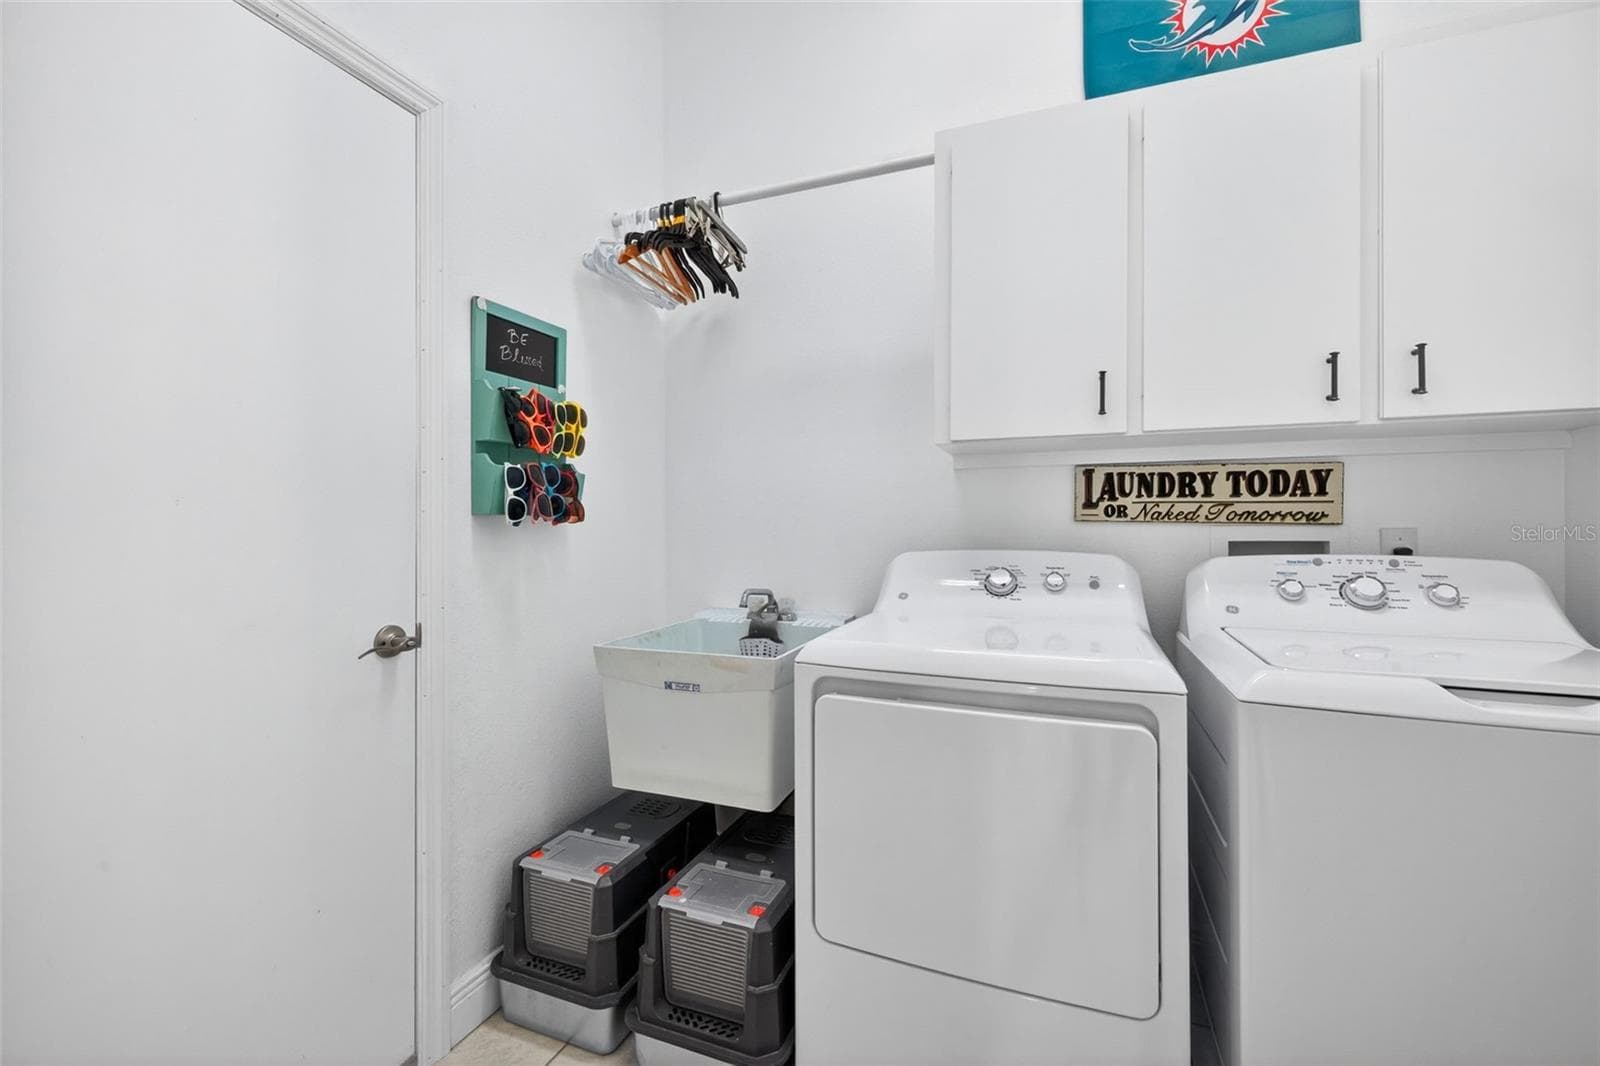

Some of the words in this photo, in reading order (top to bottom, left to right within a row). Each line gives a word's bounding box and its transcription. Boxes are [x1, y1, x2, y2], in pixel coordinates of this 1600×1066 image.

[507, 328, 529, 346] BE
[1081, 468, 1218, 509] LAUNDRY
[1225, 468, 1334, 498] TODAY
[1103, 504, 1129, 519] OR
[1130, 503, 1201, 522] Naked
[1204, 502, 1329, 522] Tomorrow
